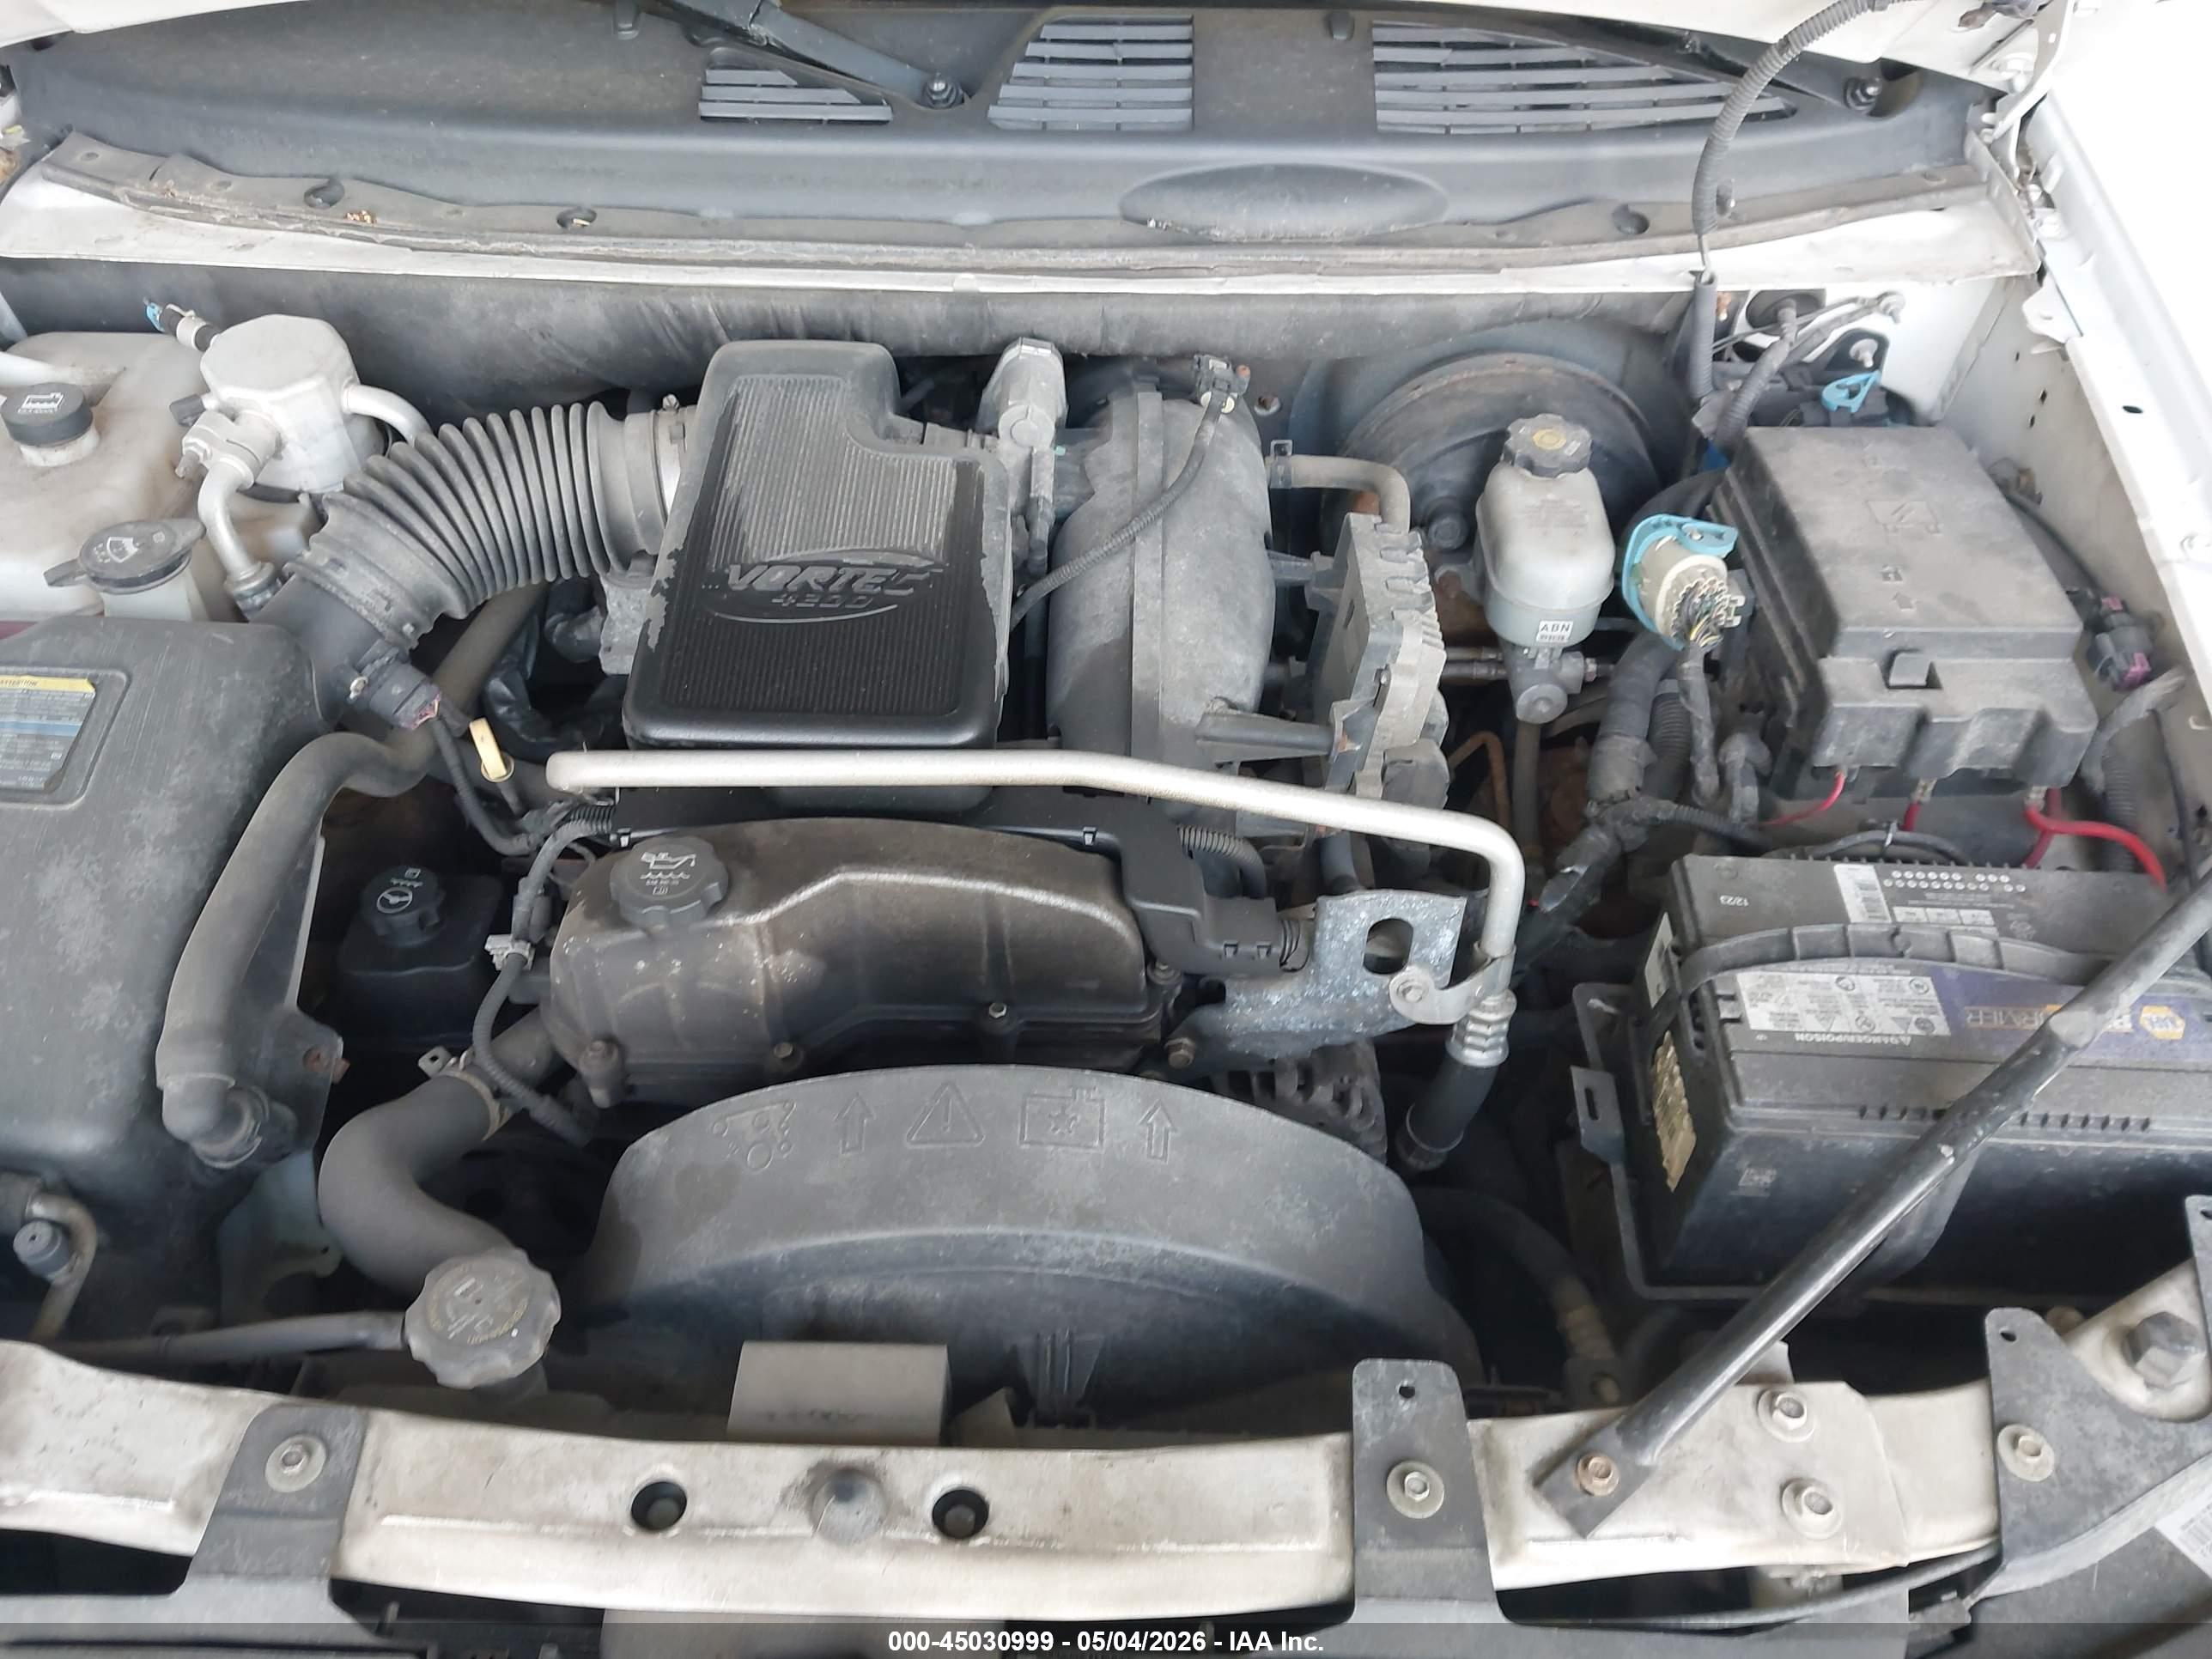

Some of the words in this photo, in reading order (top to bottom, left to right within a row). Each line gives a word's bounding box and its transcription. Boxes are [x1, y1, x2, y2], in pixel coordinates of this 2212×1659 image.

[729, 563, 936, 596] VORTEC
[771, 593, 873, 609] 4200
[1540, 623, 1571, 633] ABN
